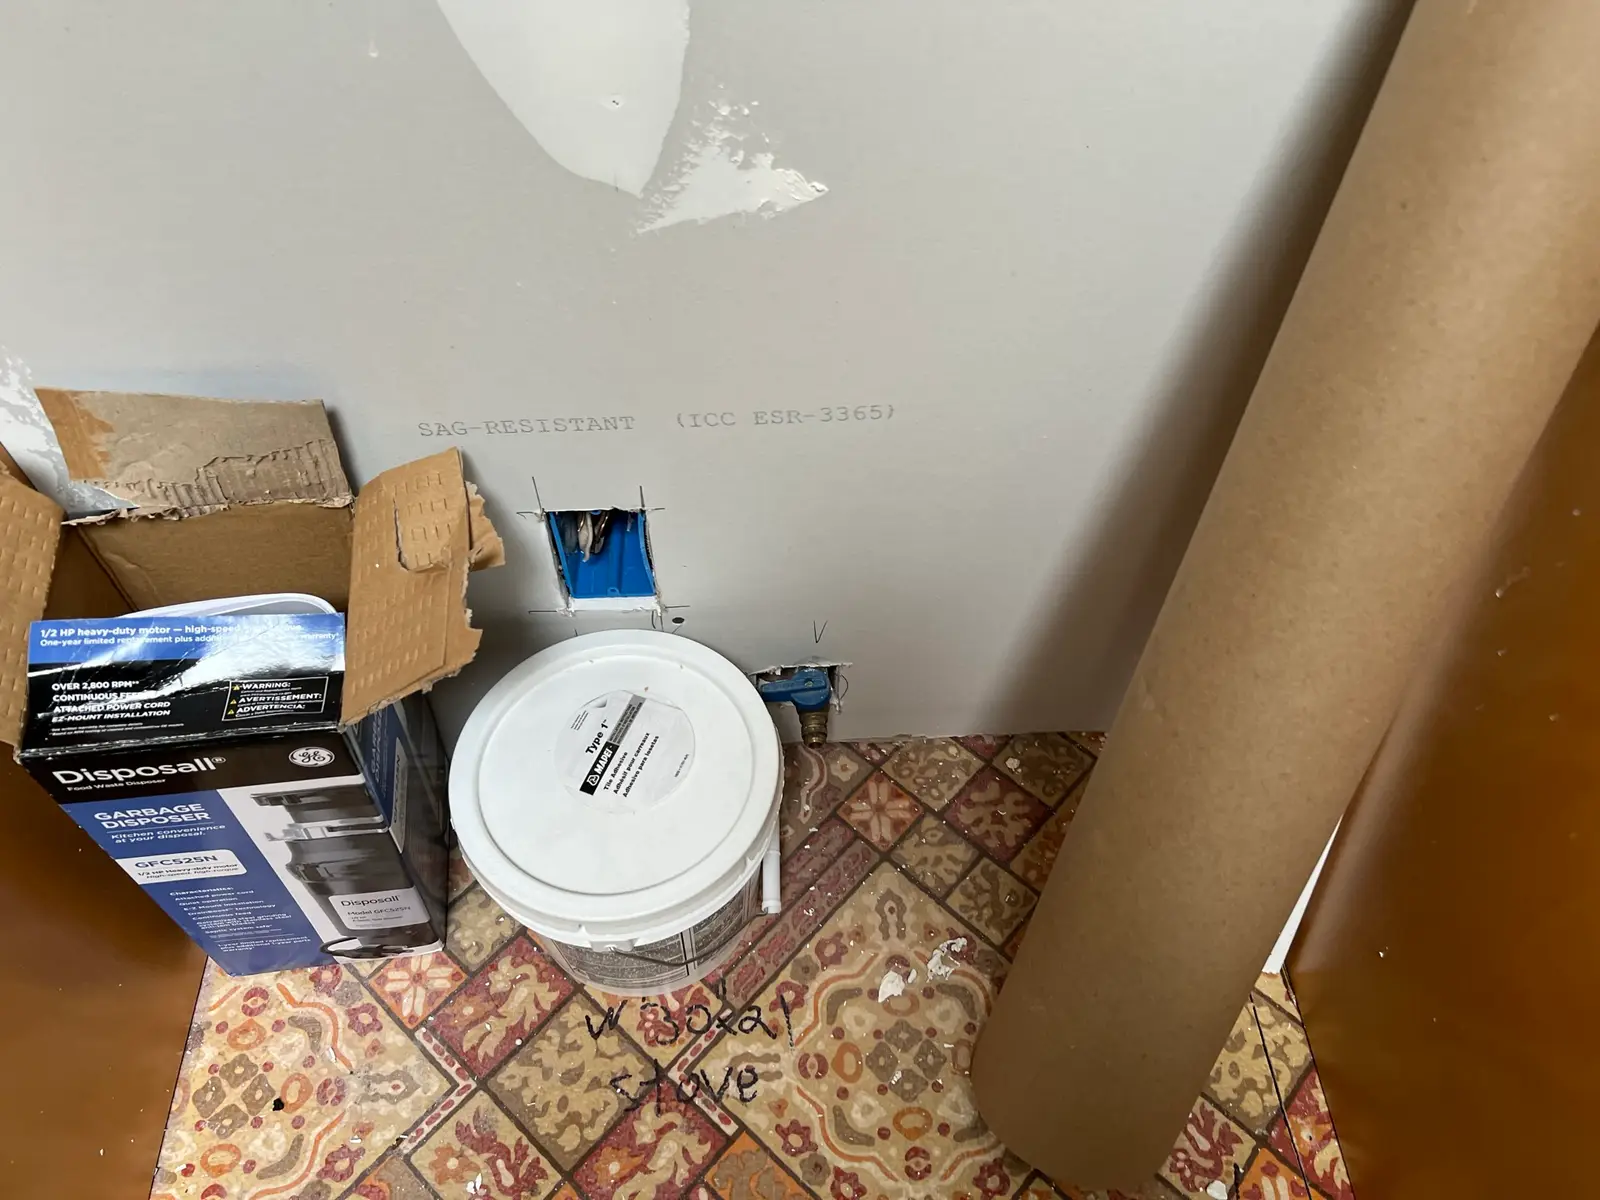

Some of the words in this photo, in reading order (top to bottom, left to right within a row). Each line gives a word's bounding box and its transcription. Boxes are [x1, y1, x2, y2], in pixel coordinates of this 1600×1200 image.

[418, 416, 635, 437] SAG-RESISTANT
[676, 411, 736, 428] (ICC
[752, 404, 896, 425] ESR-3365)
[40, 629, 57, 637] 1/2
[60, 628, 75, 637] HP
[78, 627, 136, 637] heavy-duty
[139, 626, 171, 636] motor
[40, 638, 82, 647] One-year
[84, 637, 115, 645] limited
[175, 635, 193, 644] plus
[52, 683, 80, 691] OVER
[82, 681, 110, 690] 2,800
[241, 682, 291, 690] WARNING:
[52, 693, 118, 701] CONTINUOUS
[239, 693, 322, 704] AVERTISSEMENT:
[53, 703, 105, 713] ATTACHED
[107, 702, 142, 711] POWER
[144, 701, 171, 709] CORD
[236, 704, 306, 713] ADVERTENCIA:
[52, 714, 103, 723] EZ-MOUNT
[104, 710, 171, 719] INSTALLATION
[585, 731, 603, 755] Type
[626, 758, 636, 772] pour
[634, 732, 651, 757] carreaux
[594, 746, 613, 775] MAPEI
[622, 770, 640, 798] Adhesivo
[638, 756, 648, 771] para
[646, 735, 660, 757] losetas
[603, 779, 613, 791] Tile
[610, 751, 629, 778] Adhesive
[94, 803, 205, 820] GARBAGE
[101, 813, 211, 829] DISPOSER
[111, 831, 155, 840] Kitchen
[157, 824, 226, 835] convenience
[130, 835, 155, 843] your
[157, 831, 206, 840] disposal.
[134, 855, 219, 869] GFC525N
